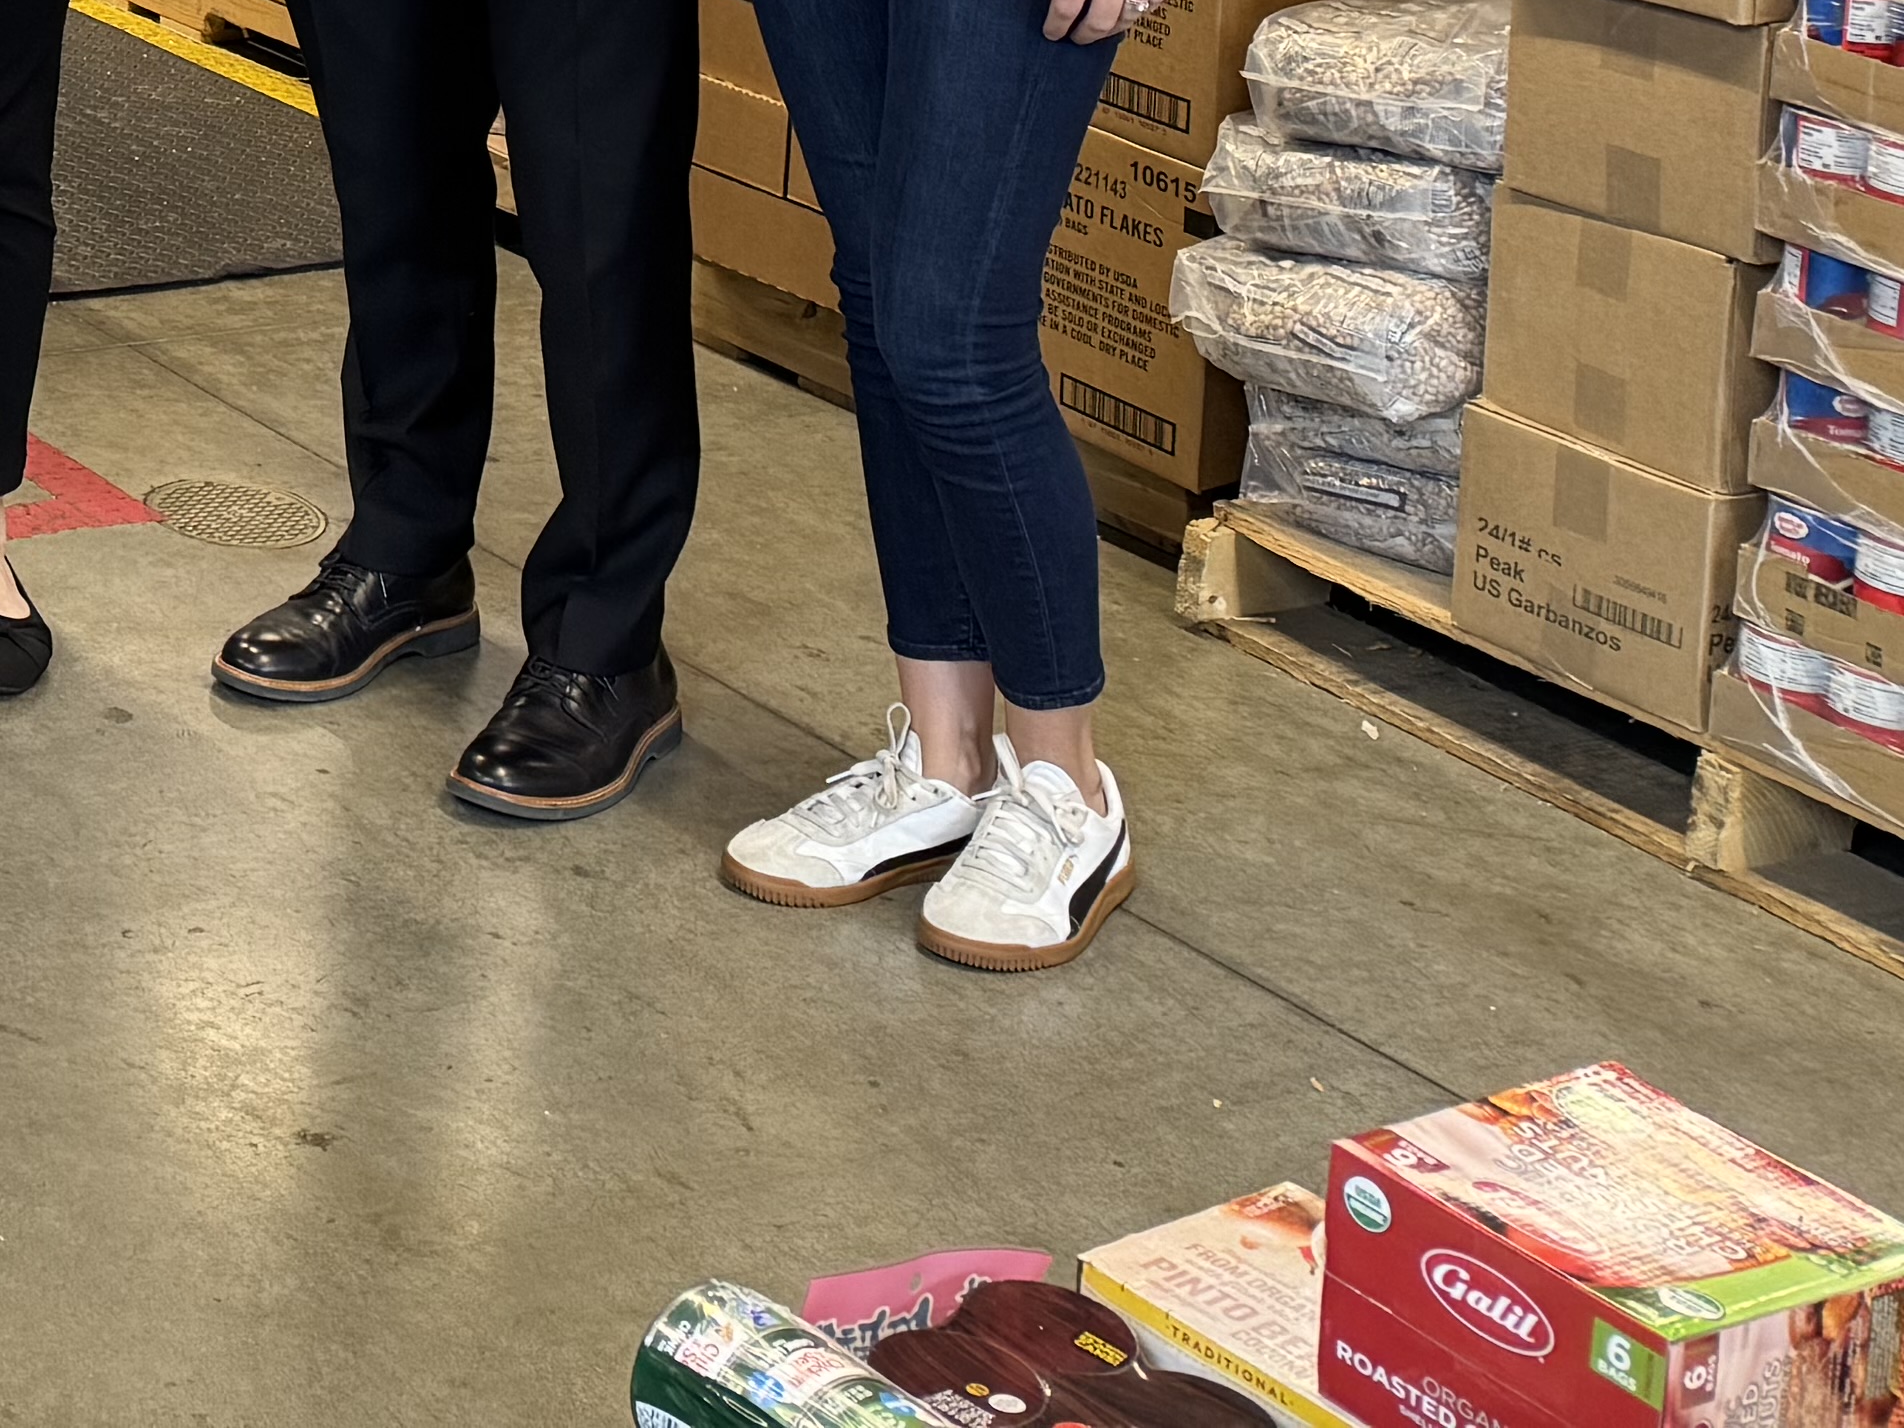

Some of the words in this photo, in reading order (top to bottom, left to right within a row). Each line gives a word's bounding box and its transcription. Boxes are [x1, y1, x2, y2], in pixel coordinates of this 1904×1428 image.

[1133, 30, 1164, 50] PLACE
[1130, 160, 1197, 204] 10615
[1063, 191, 1094, 220] ATO
[1100, 206, 1164, 248] FLAKES
[1064, 217, 1088, 235] BAGS
[1046, 244, 1096, 272] STRIBUTED
[1098, 263, 1110, 277] BY
[1113, 270, 1138, 290] USDA
[1072, 267, 1096, 286] WITH
[1098, 278, 1125, 300] STATE
[1128, 290, 1147, 308] AND
[1044, 270, 1110, 310] GOVERNMENTS
[1111, 301, 1129, 317] FOR
[1132, 307, 1180, 339] DOMESTIC
[1045, 288, 1099, 319] ASSISTANCE
[1101, 310, 1153, 343] PROGRAMS
[1047, 303, 1059, 316] BE
[1061, 308, 1085, 329] SOLD
[1086, 319, 1099, 334] OR
[1101, 324, 1156, 360] EXCHANGED
[1049, 318, 1059, 331] IN
[1061, 322, 1069, 334] A
[1098, 338, 1116, 356] DRY
[1119, 343, 1149, 373] PLACE
[1477, 516, 1533, 553] 24/1#
[1475, 544, 1527, 584] Peak
[1473, 569, 1502, 599] US
[1507, 587, 1622, 652] Garbanzos
[1708, 632, 1735, 656] Pe
[1184, 1242, 1248, 1279] FROM
[1141, 1256, 1260, 1323] PINTO
[1431, 1263, 1540, 1344] Galil
[1169, 1324, 1289, 1407] TRADITIONAL
[1596, 1359, 1638, 1393] BAGS
[1606, 1335, 1633, 1372] 6
[1336, 1339, 1457, 1428] ROASTED
[1683, 1366, 1708, 1392] 6
